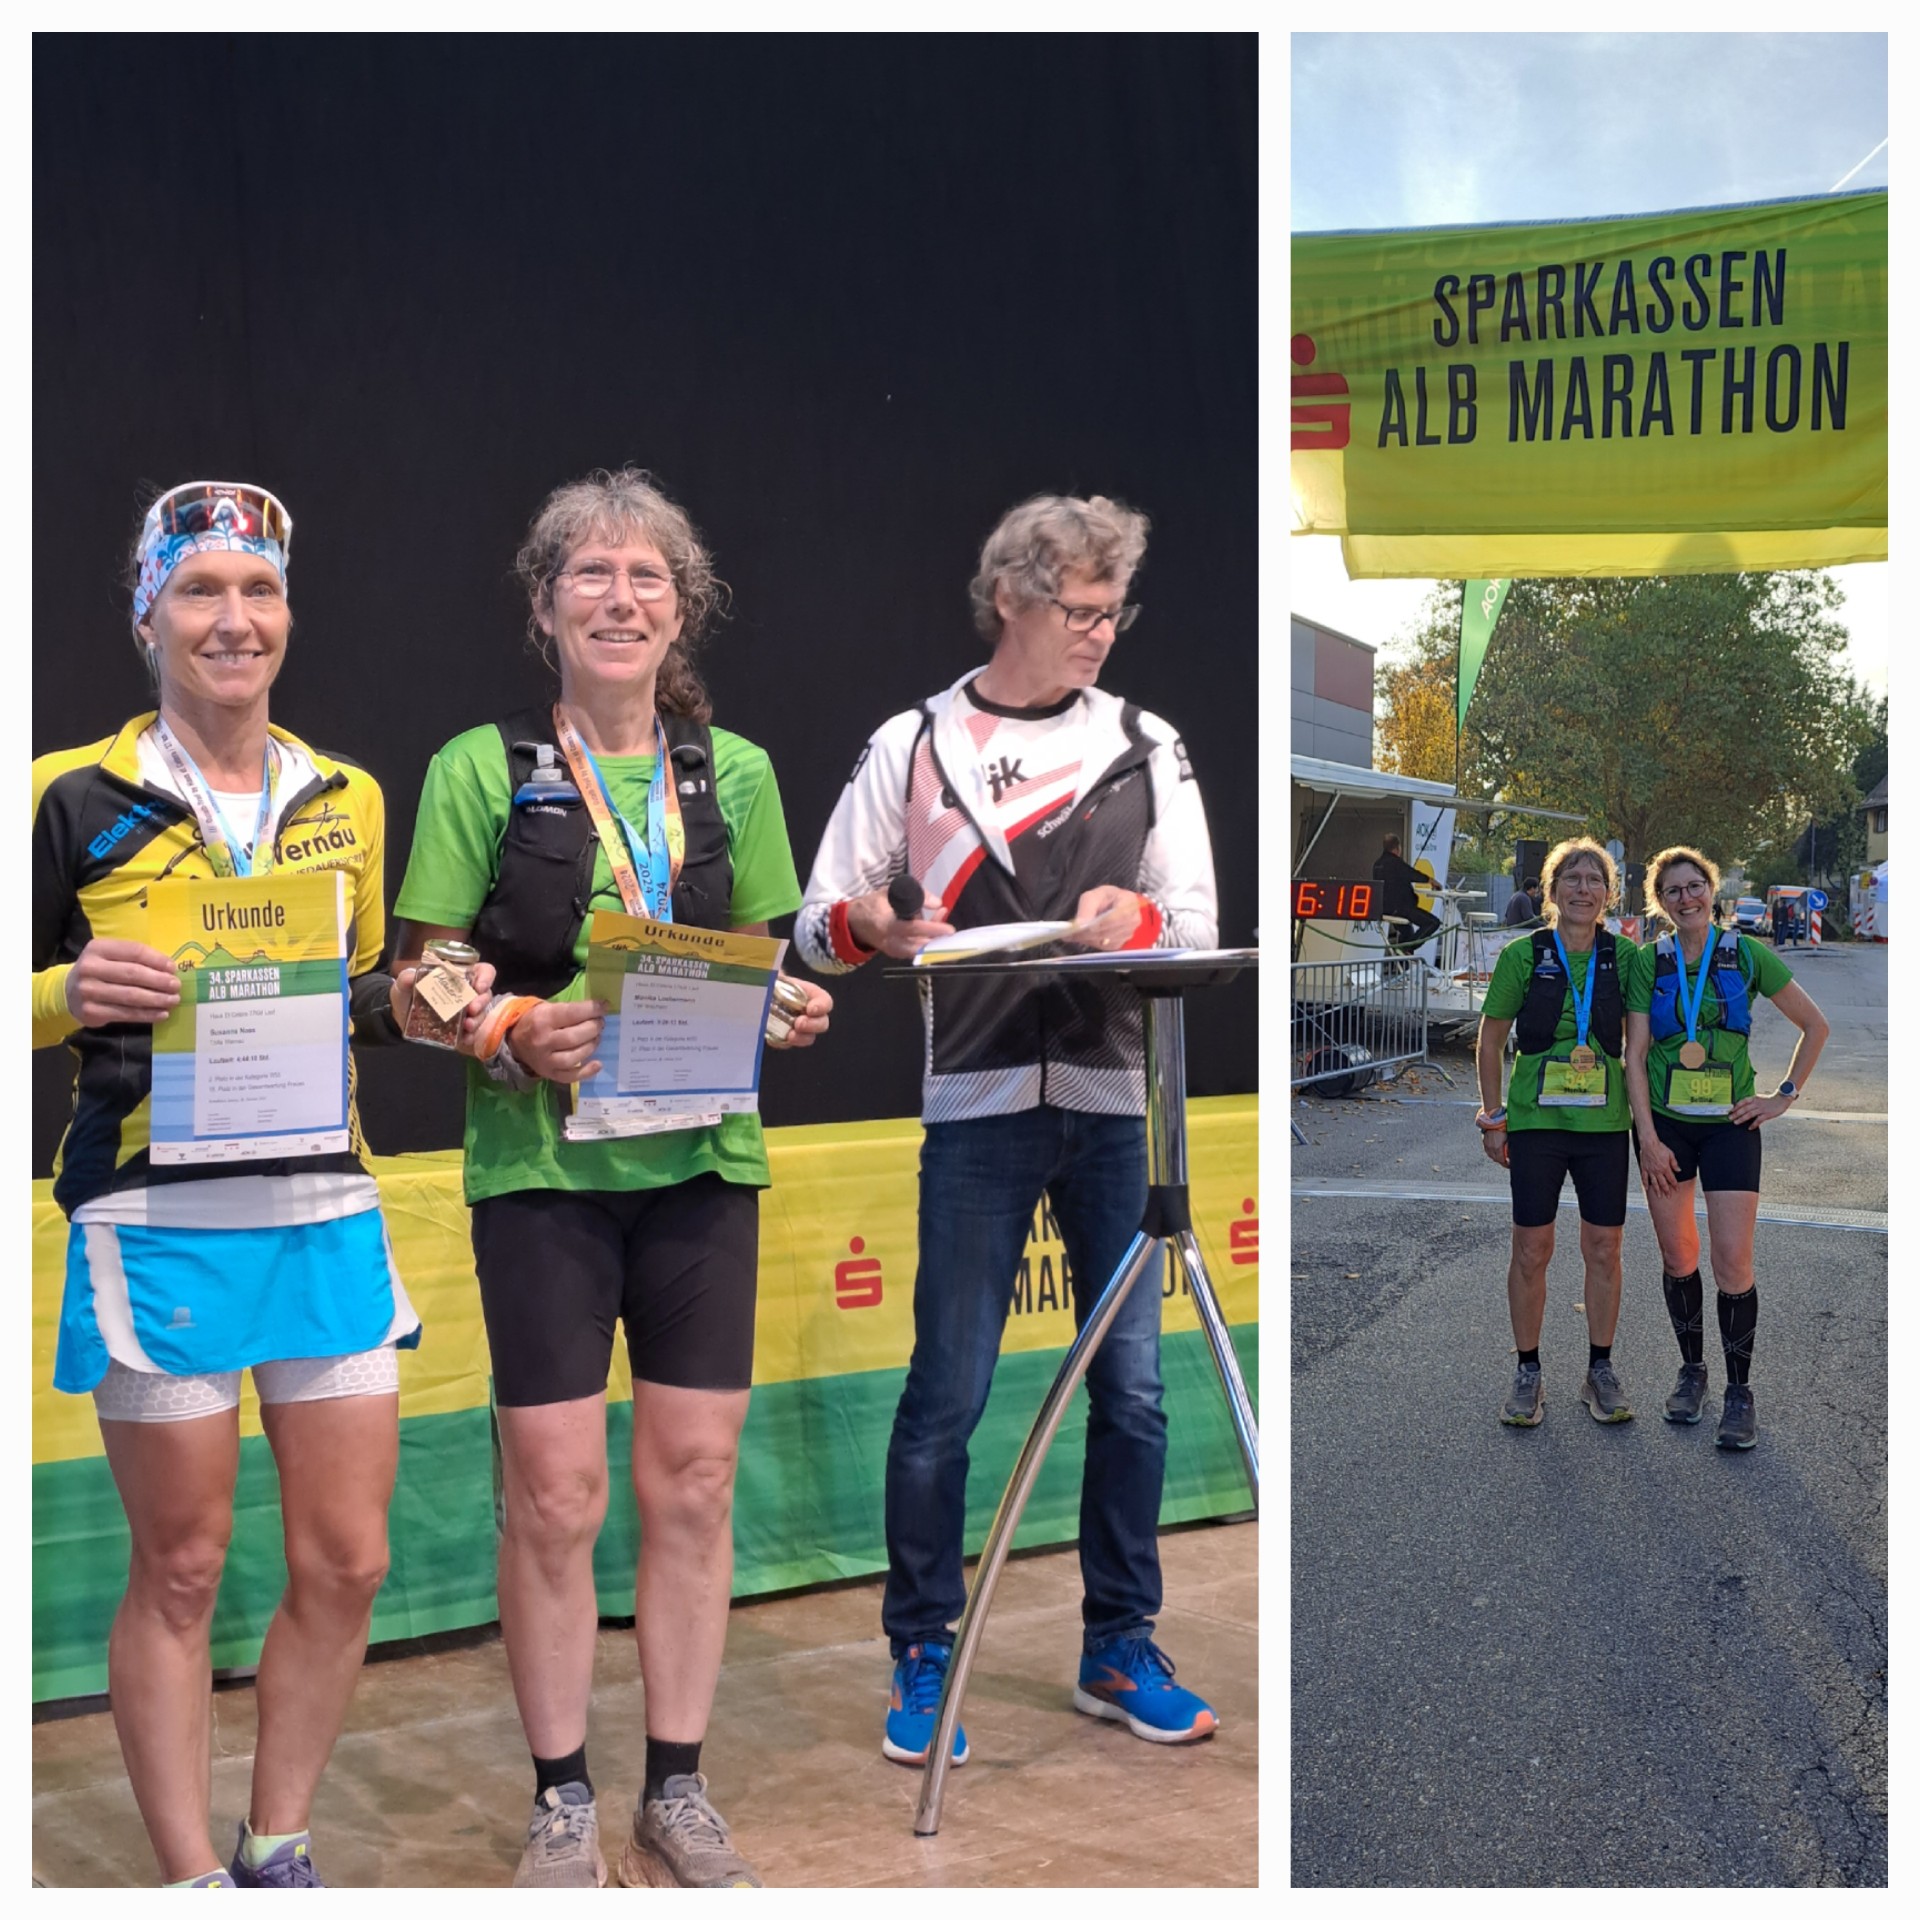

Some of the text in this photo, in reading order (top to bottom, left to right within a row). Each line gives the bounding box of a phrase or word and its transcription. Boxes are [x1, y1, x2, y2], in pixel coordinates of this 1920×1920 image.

[1433, 248, 1787, 347] SPARKASSEN
[1378, 341, 1850, 448] ALB MARATHON
[1297, 882, 1372, 917] 6:18
[202, 900, 285, 931] Urkunde
[644, 924, 725, 947] Urkunde
[640, 954, 710, 969] 34. SPARKASSEN
[658, 965, 708, 978] MARATHON
[209, 967, 280, 985] 34. SPARKASSEN
[209, 981, 280, 1000] ALB MARATHON
[1691, 1079, 1712, 1096] 99
